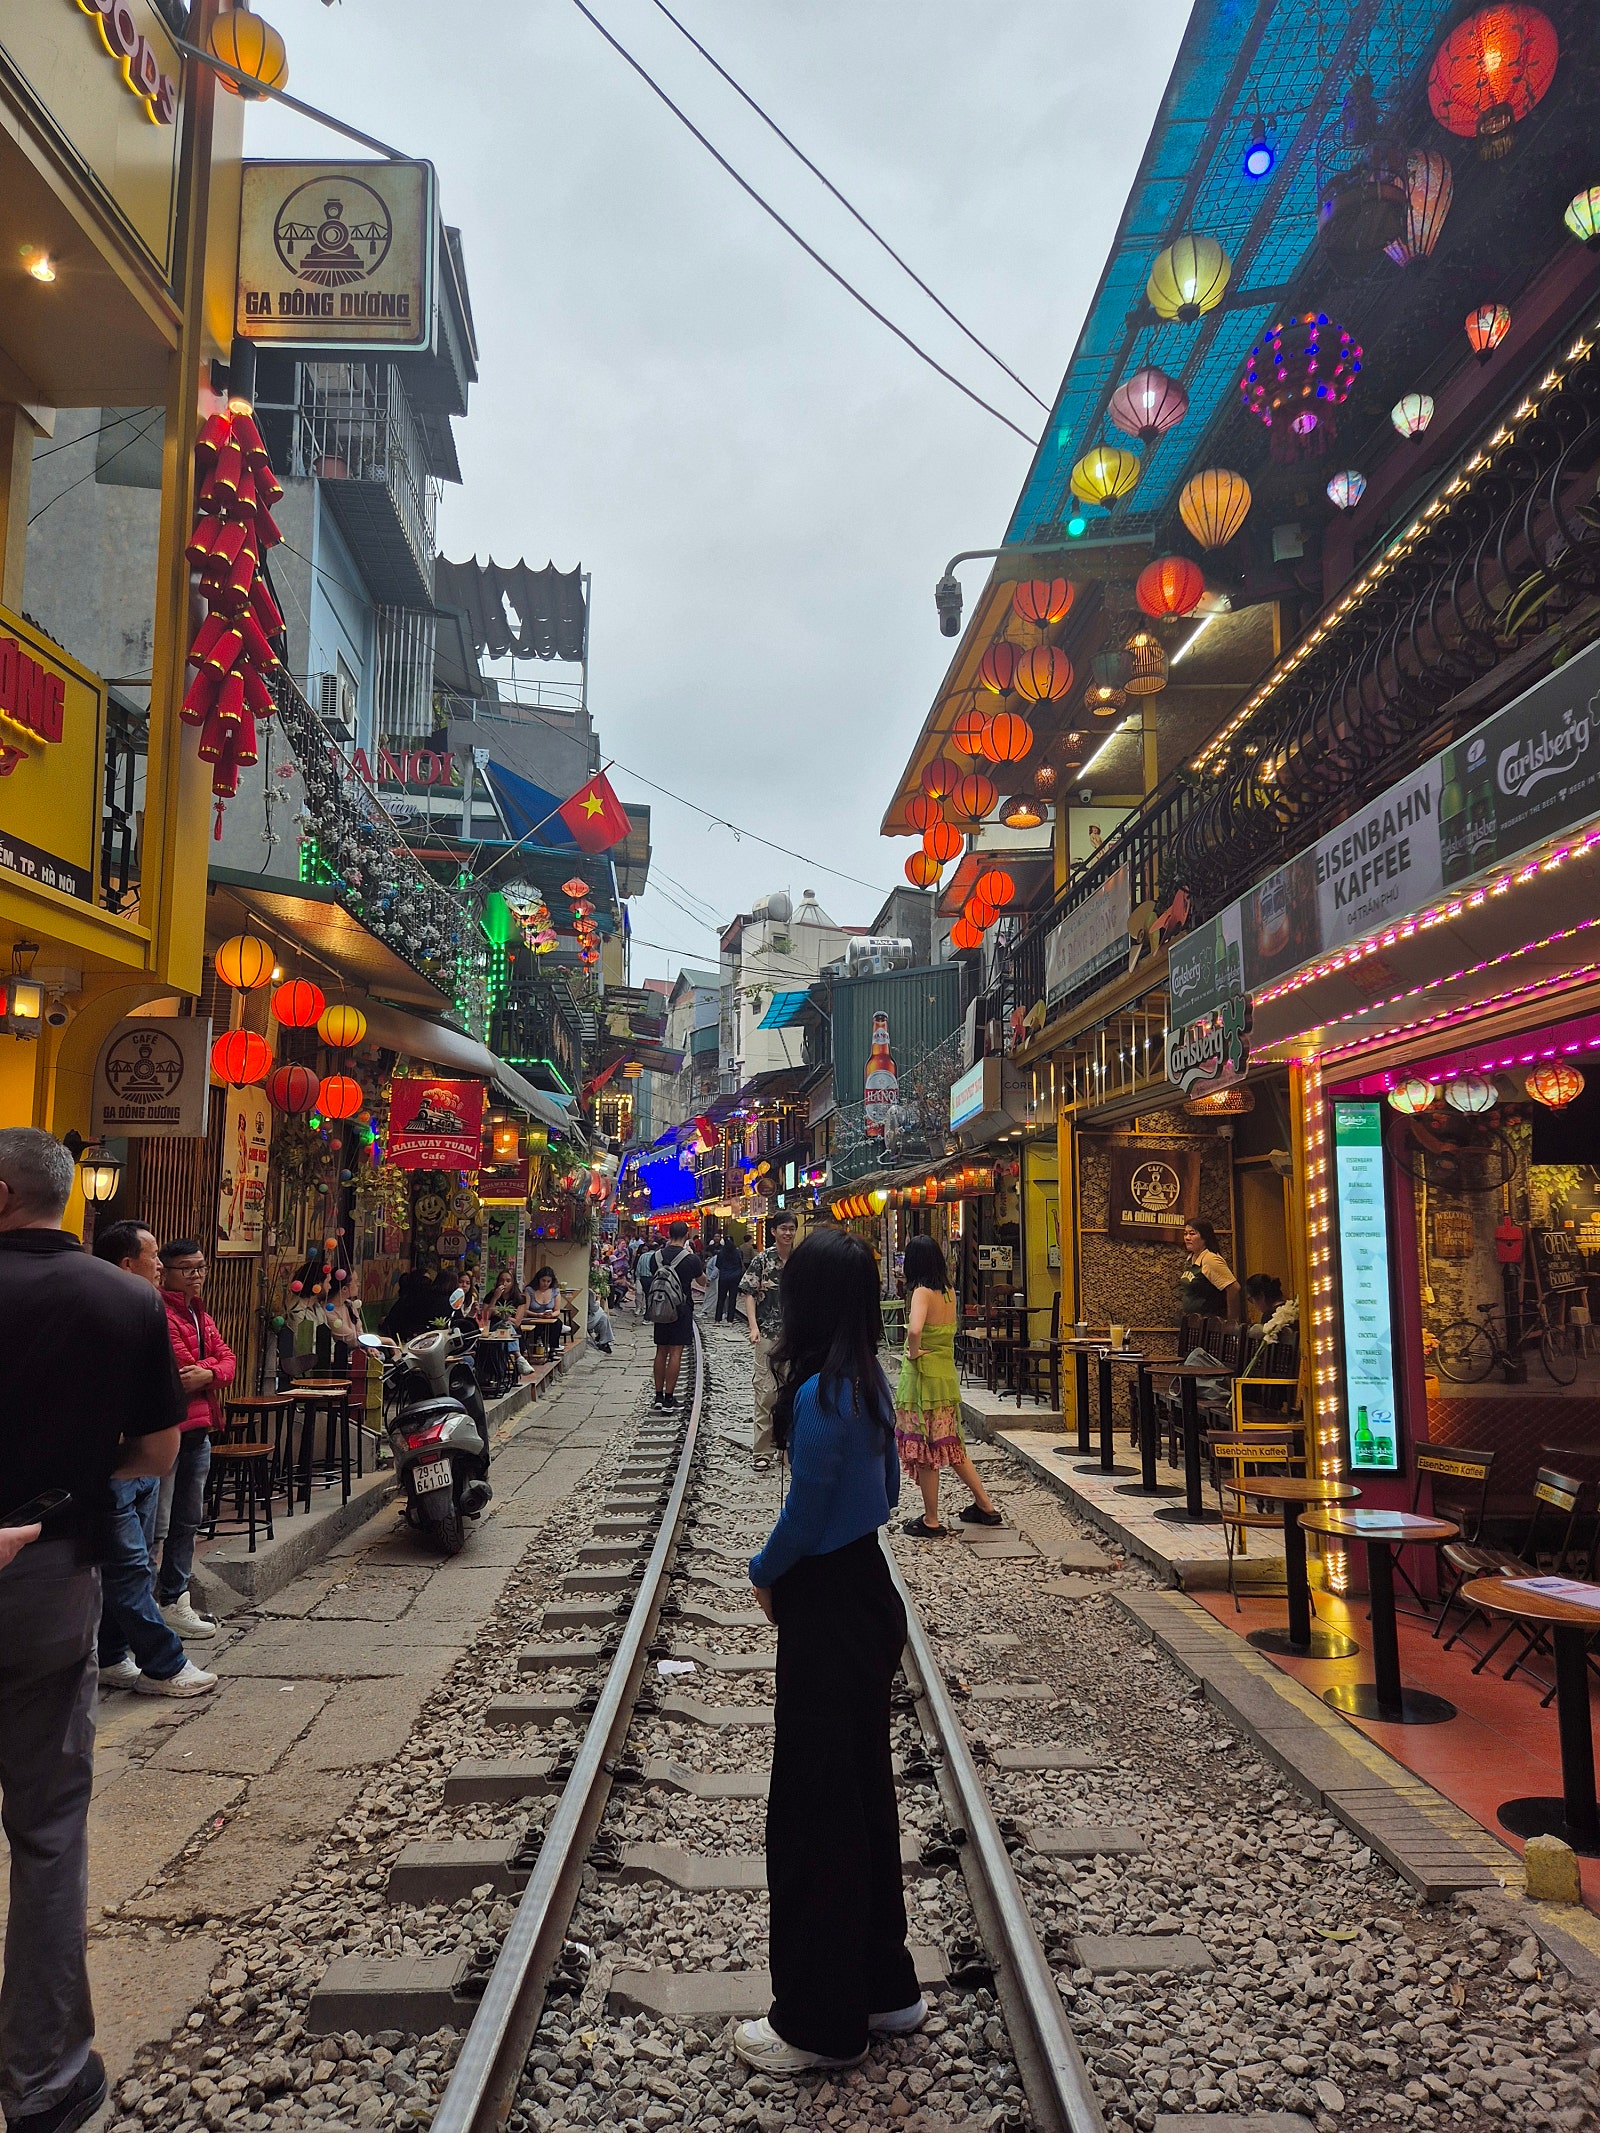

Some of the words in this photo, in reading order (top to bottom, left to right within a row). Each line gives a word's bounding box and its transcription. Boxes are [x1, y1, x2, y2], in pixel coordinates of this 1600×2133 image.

[84, 0, 175, 124] ODS
[245, 291, 272, 315] GA
[278, 288, 334, 316] ĐÔNG
[340, 290, 410, 317] DƯƠNG
[1497, 710, 1590, 797] Carlsberg
[1315, 783, 1432, 886] EISENBAHN
[20, 856, 38, 878] TP.
[41, 863, 56, 886] HÀ
[1334, 837, 1412, 910] KAFFEE
[132, 1033, 158, 1045] CAFÉ
[1167, 1018, 1224, 1094] Carlsberg
[391, 1140, 442, 1153] RAILWAY
[444, 1140, 474, 1154] TUAN
[421, 1152, 446, 1161] Café
[1122, 1210, 1133, 1221] GA
[443, 1237, 460, 1246] NO
[1216, 1446, 1258, 1456] Eisenbahn
[1259, 1447, 1287, 1456] Kaffee
[1418, 1457, 1459, 1474] Eisenbahn
[1460, 1465, 1484, 1477] Kaffee
